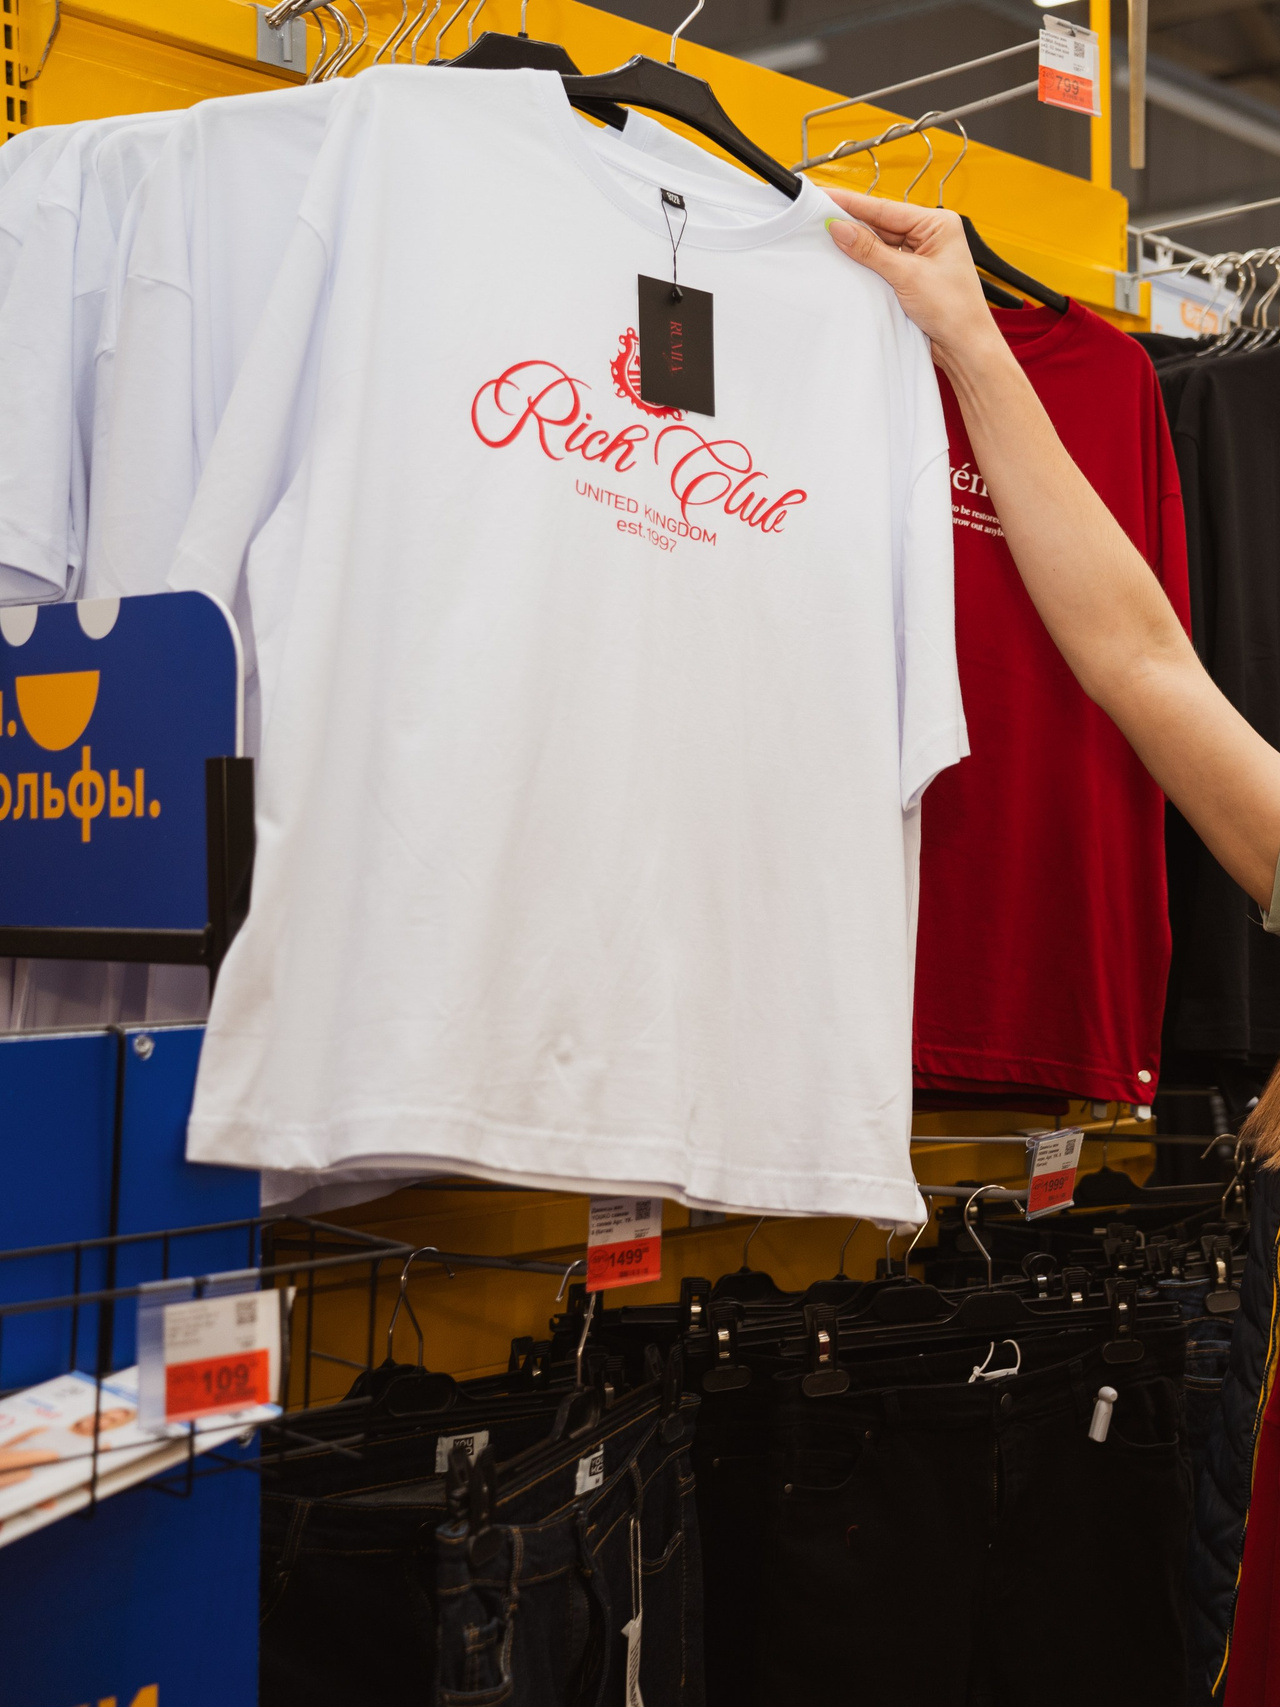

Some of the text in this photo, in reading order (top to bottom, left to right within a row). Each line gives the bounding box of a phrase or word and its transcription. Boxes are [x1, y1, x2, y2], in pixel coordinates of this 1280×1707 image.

[1055, 75, 1080, 95] 799
[471, 359, 808, 534] Rich Club
[575, 478, 718, 547] UNITED KINGDOM
[960, 505, 971, 516] be
[970, 522, 984, 532] out
[1043, 1177, 1065, 1193] 1999
[609, 1248, 643, 1267] 1499
[202, 1363, 250, 1394] 109
[453, 1439, 472, 1447] YOU
